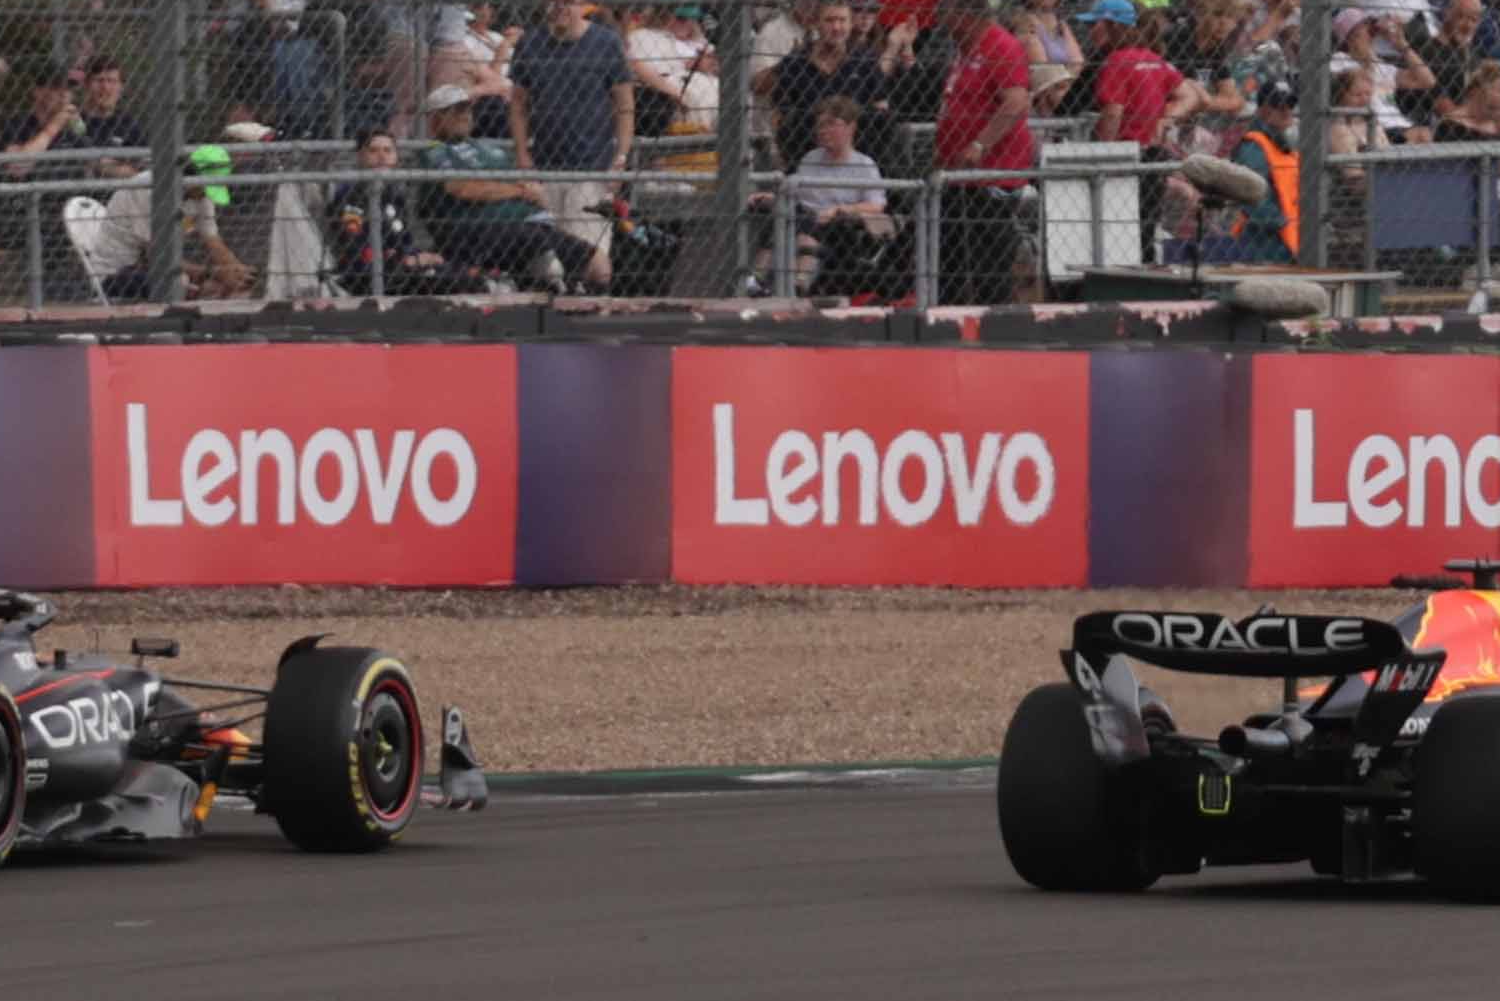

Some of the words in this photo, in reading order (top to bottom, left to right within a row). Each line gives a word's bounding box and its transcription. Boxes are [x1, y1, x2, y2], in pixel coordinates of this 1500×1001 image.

[127, 402, 477, 526] Lenovo
[713, 403, 1054, 526] Lenovo
[1112, 613, 1371, 655] ORACLE
